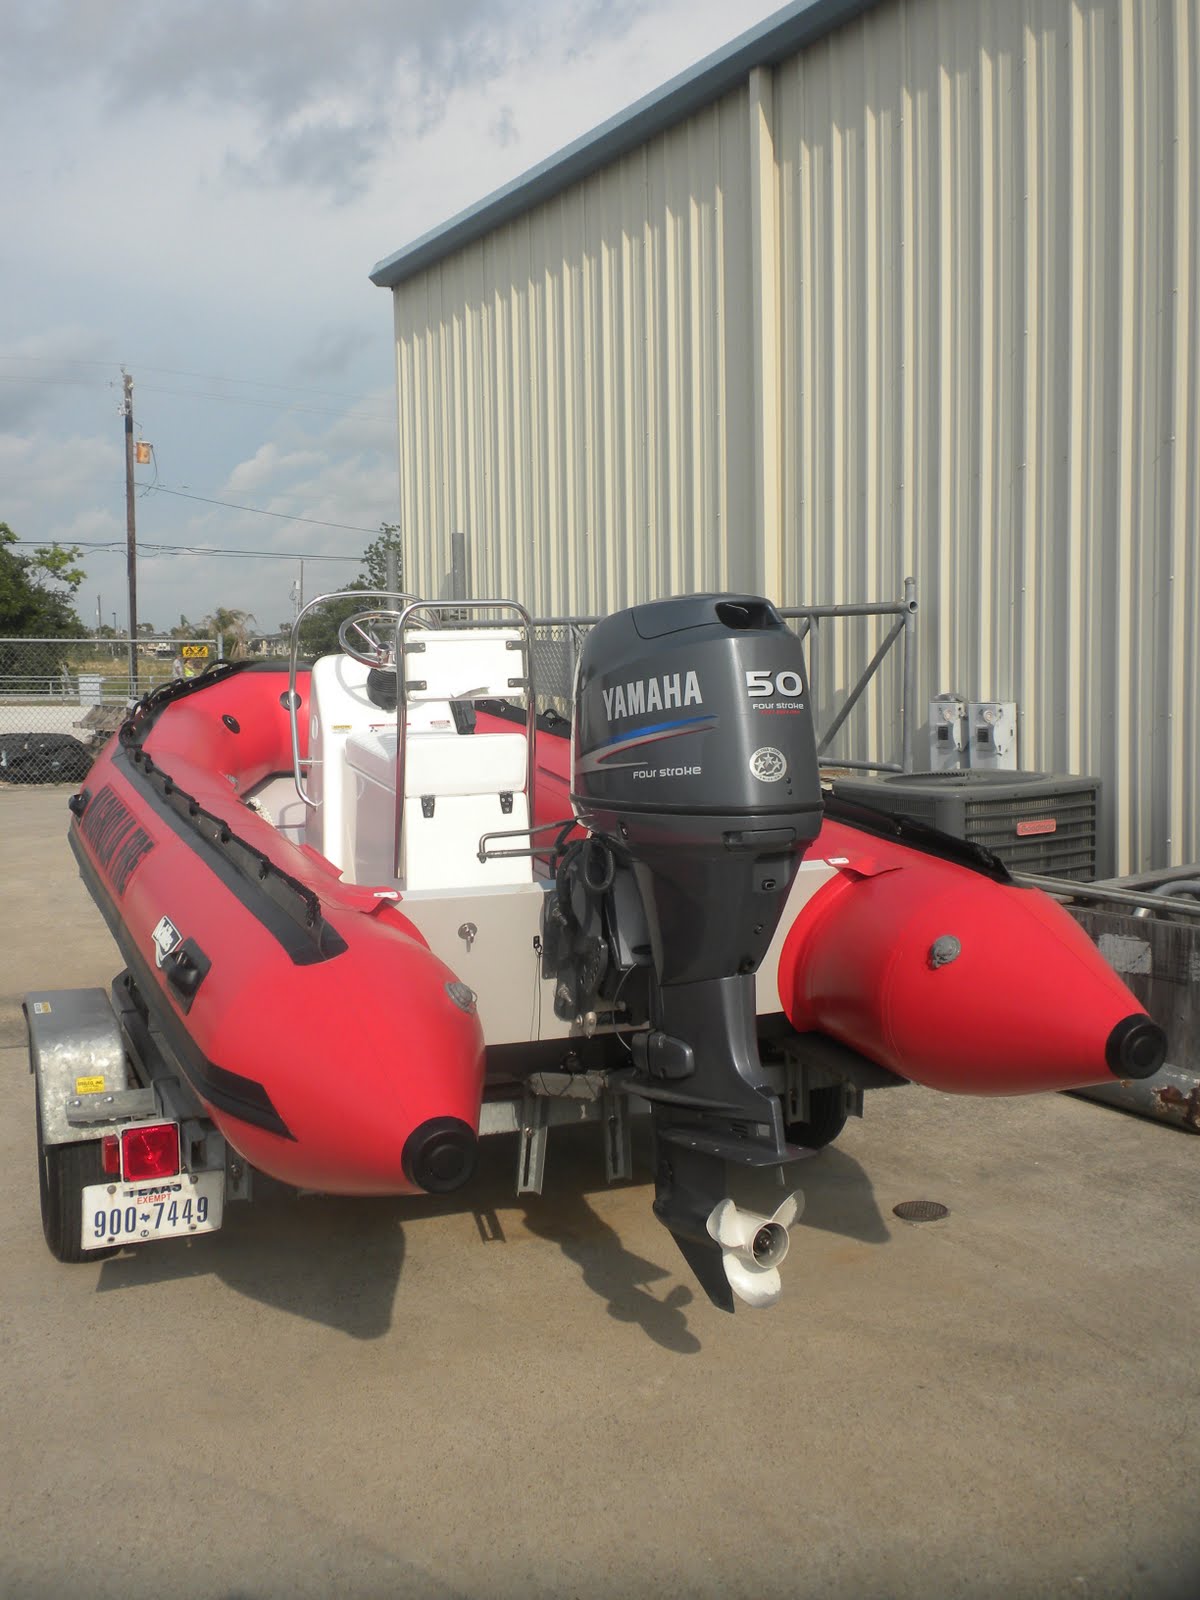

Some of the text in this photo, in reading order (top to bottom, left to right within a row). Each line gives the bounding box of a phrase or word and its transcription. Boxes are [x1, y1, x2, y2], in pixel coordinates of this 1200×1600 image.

[602, 670, 703, 721] YAMAHA
[746, 670, 803, 697] 50
[136, 1193, 172, 1205] EXEMPT
[94, 1196, 209, 1238] 900 7449
